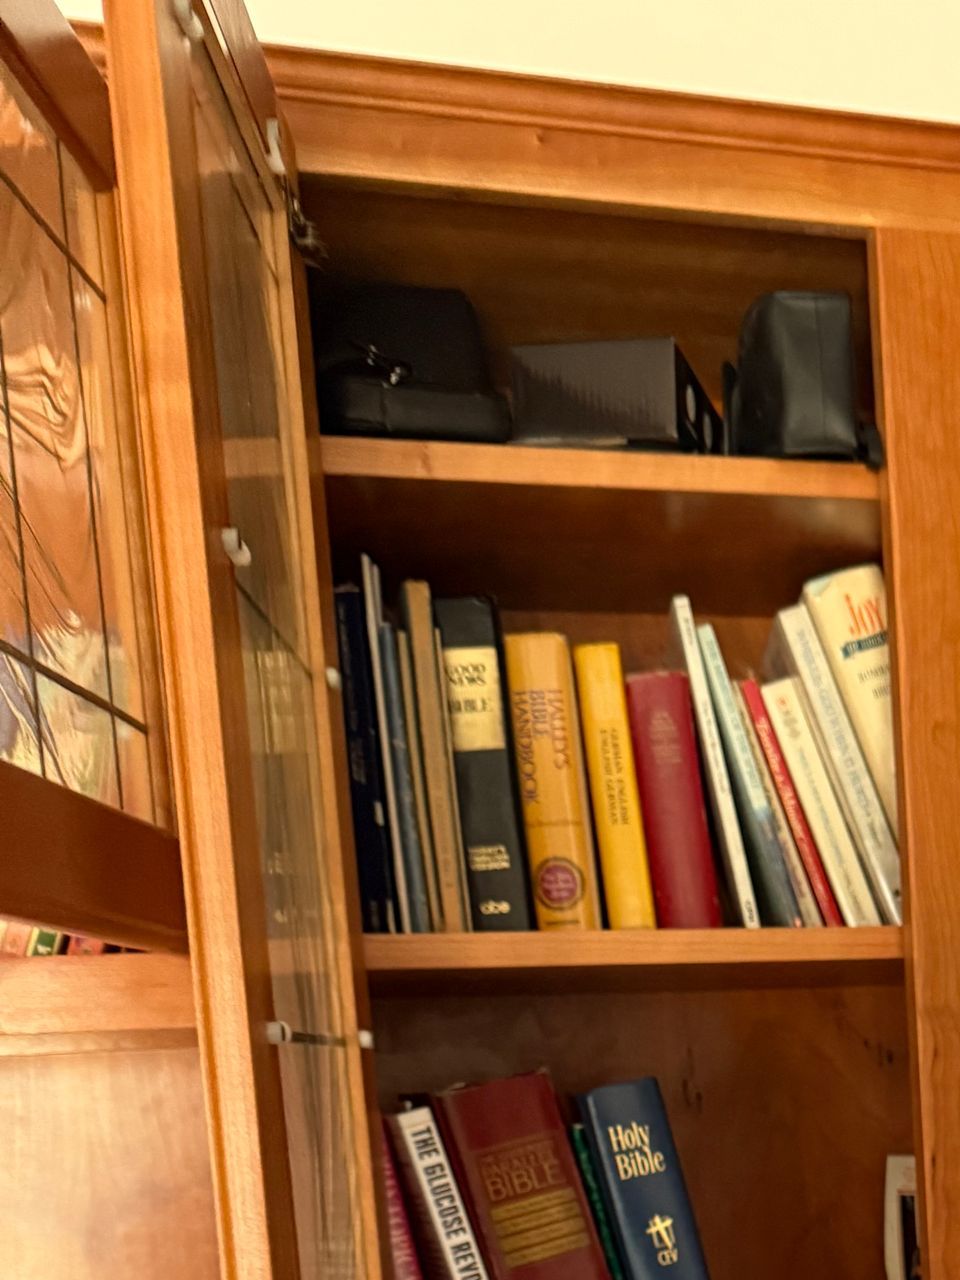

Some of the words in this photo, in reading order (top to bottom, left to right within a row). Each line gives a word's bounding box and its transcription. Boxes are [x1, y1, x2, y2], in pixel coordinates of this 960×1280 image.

[527, 688, 549, 741] BIBLE
[544, 686, 571, 770] HALLEY'S
[510, 689, 541, 804] HANDBOOK
[410, 1125, 440, 1161] THE
[608, 1121, 651, 1152] Holy
[485, 1158, 566, 1202] BIBLE
[614, 1146, 667, 1181] Bible
[422, 1160, 468, 1242] GLUCOSE
